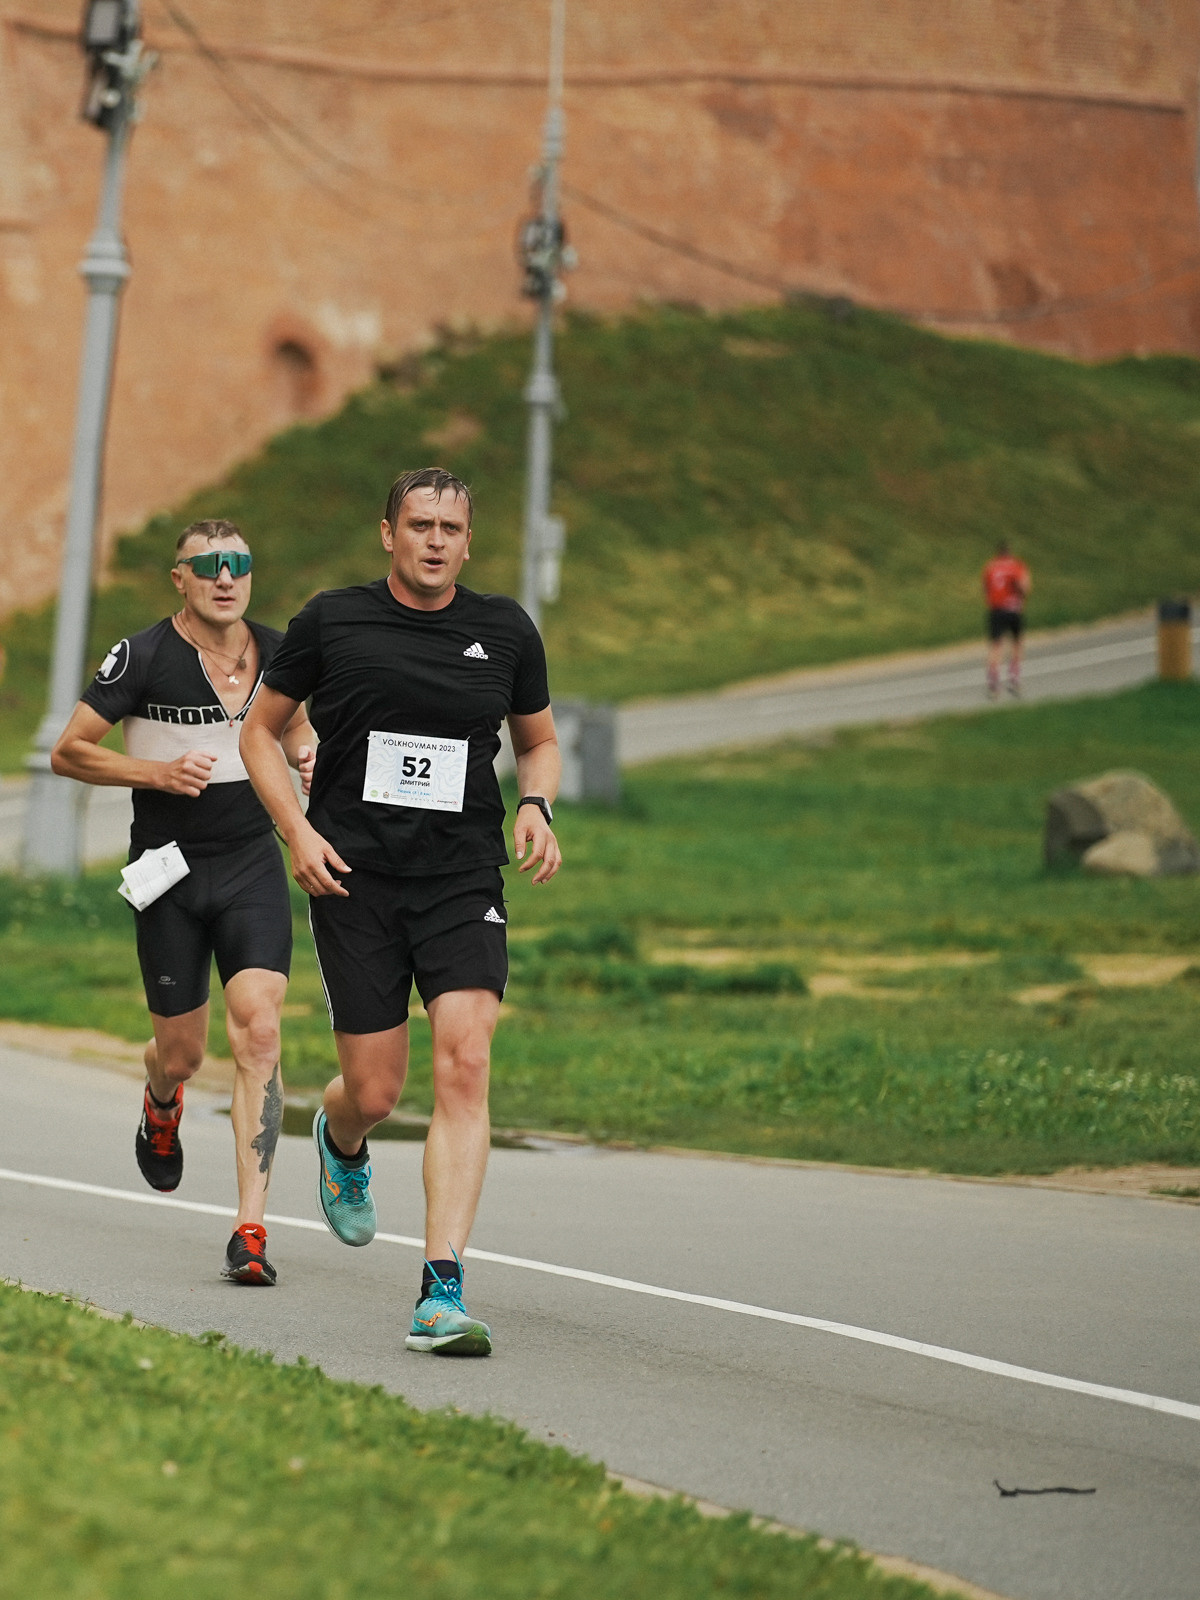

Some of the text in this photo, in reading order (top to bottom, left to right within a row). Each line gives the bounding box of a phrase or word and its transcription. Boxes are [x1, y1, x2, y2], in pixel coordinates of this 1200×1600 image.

[463, 650, 489, 660] adidas
[148, 704, 247, 725] IRON
[382, 738, 456, 752] VOLKHOVMAN 2023
[401, 755, 432, 779] 52
[399, 779, 431, 788] ДМИТРИЙ
